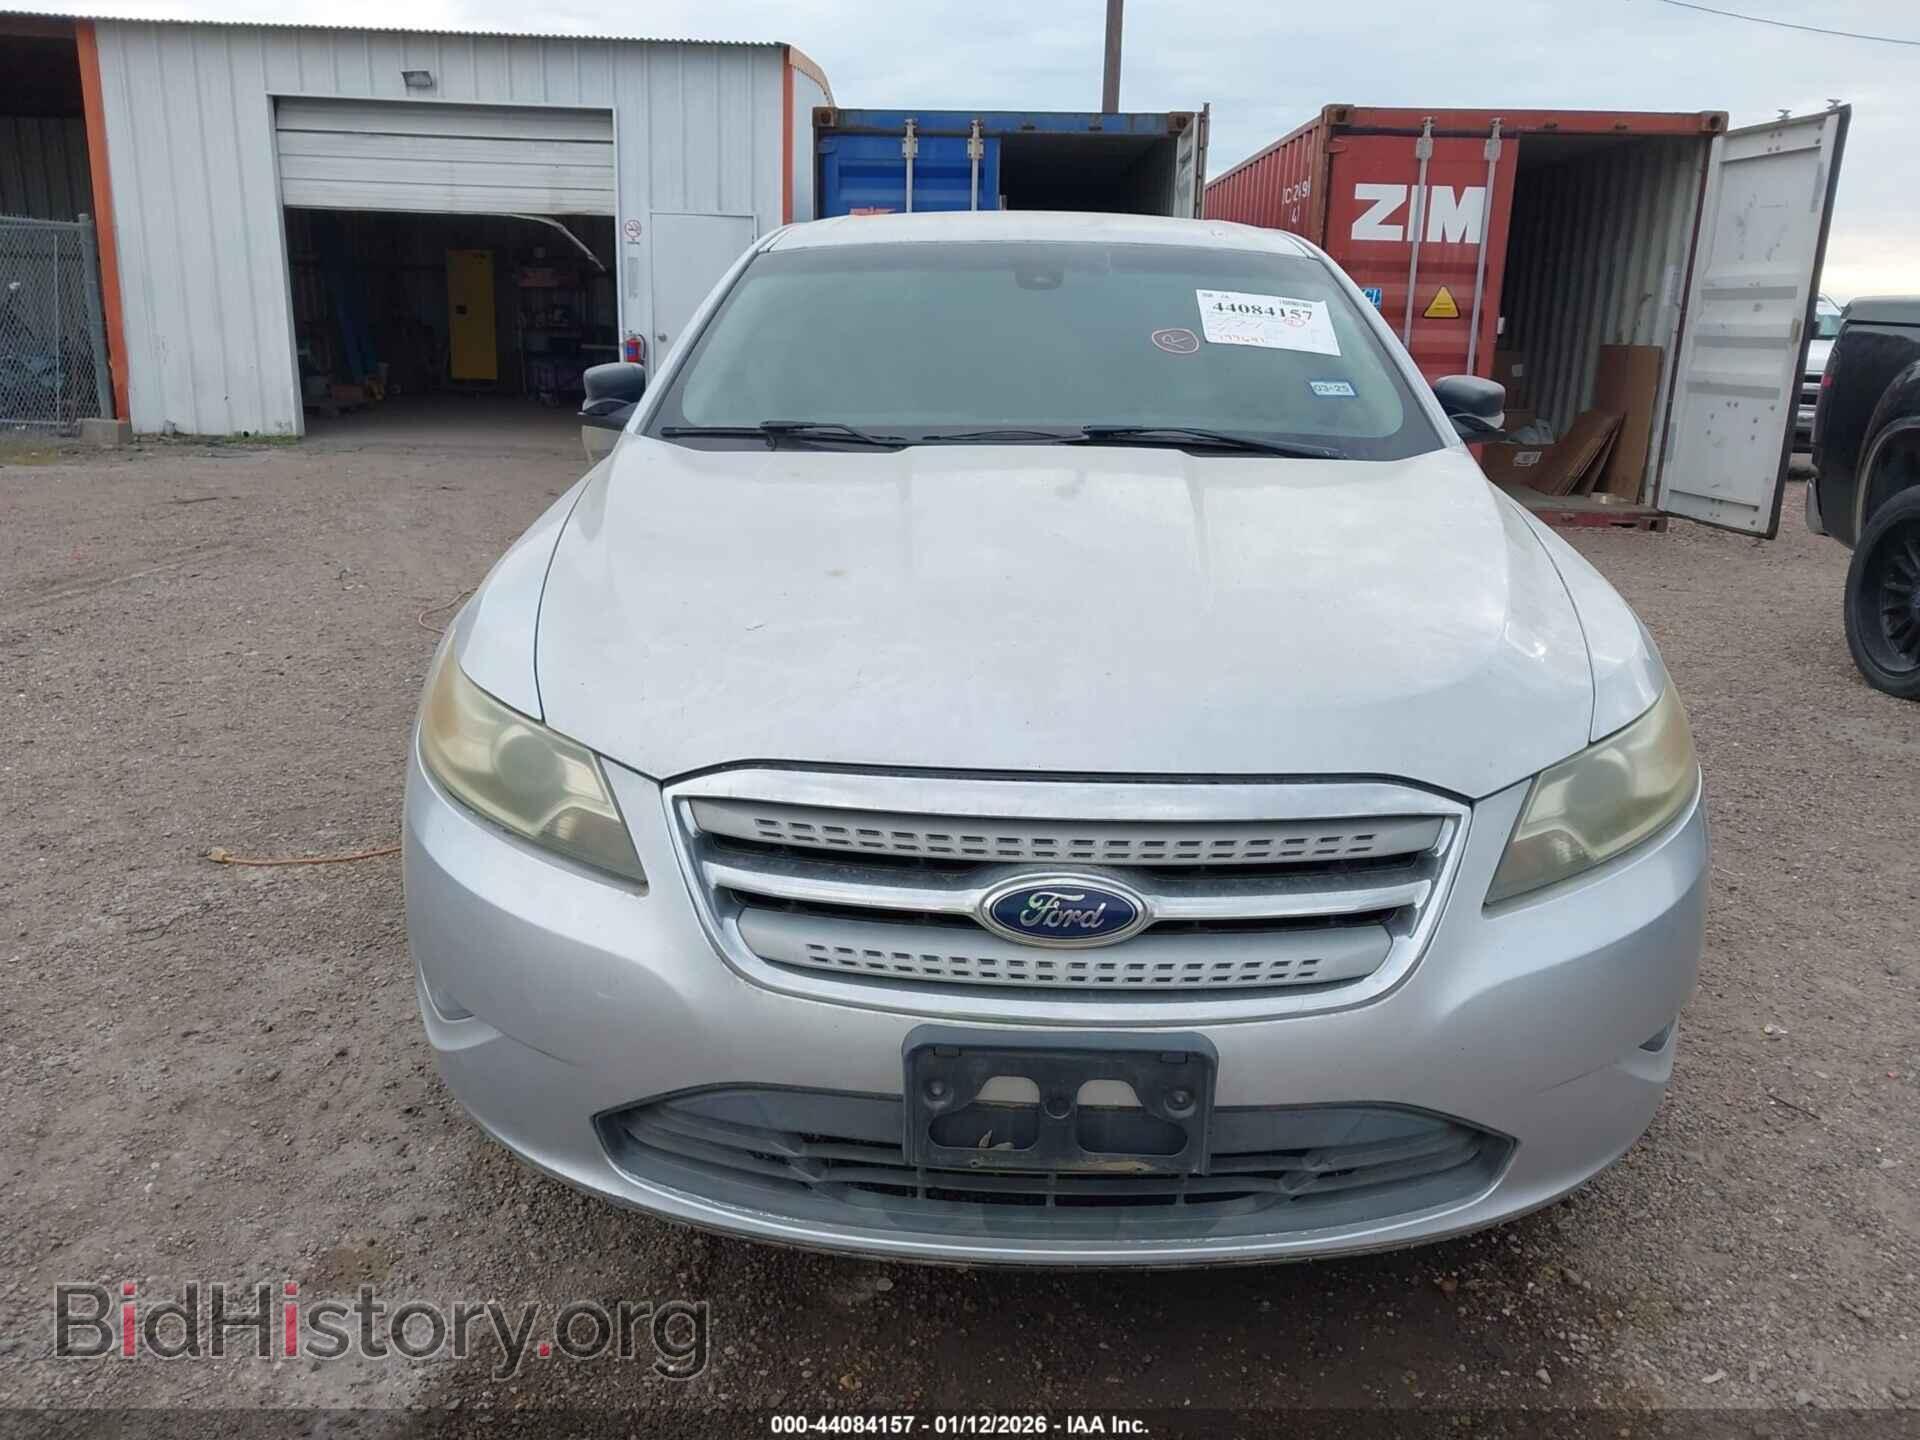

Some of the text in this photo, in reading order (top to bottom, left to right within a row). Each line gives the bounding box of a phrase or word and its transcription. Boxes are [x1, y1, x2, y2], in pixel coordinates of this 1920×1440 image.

[1351, 183, 1486, 244] ZIM
[1212, 301, 1313, 321] 44084157
[1313, 383, 1350, 393] 03-25
[1019, 891, 1106, 929] Ford
